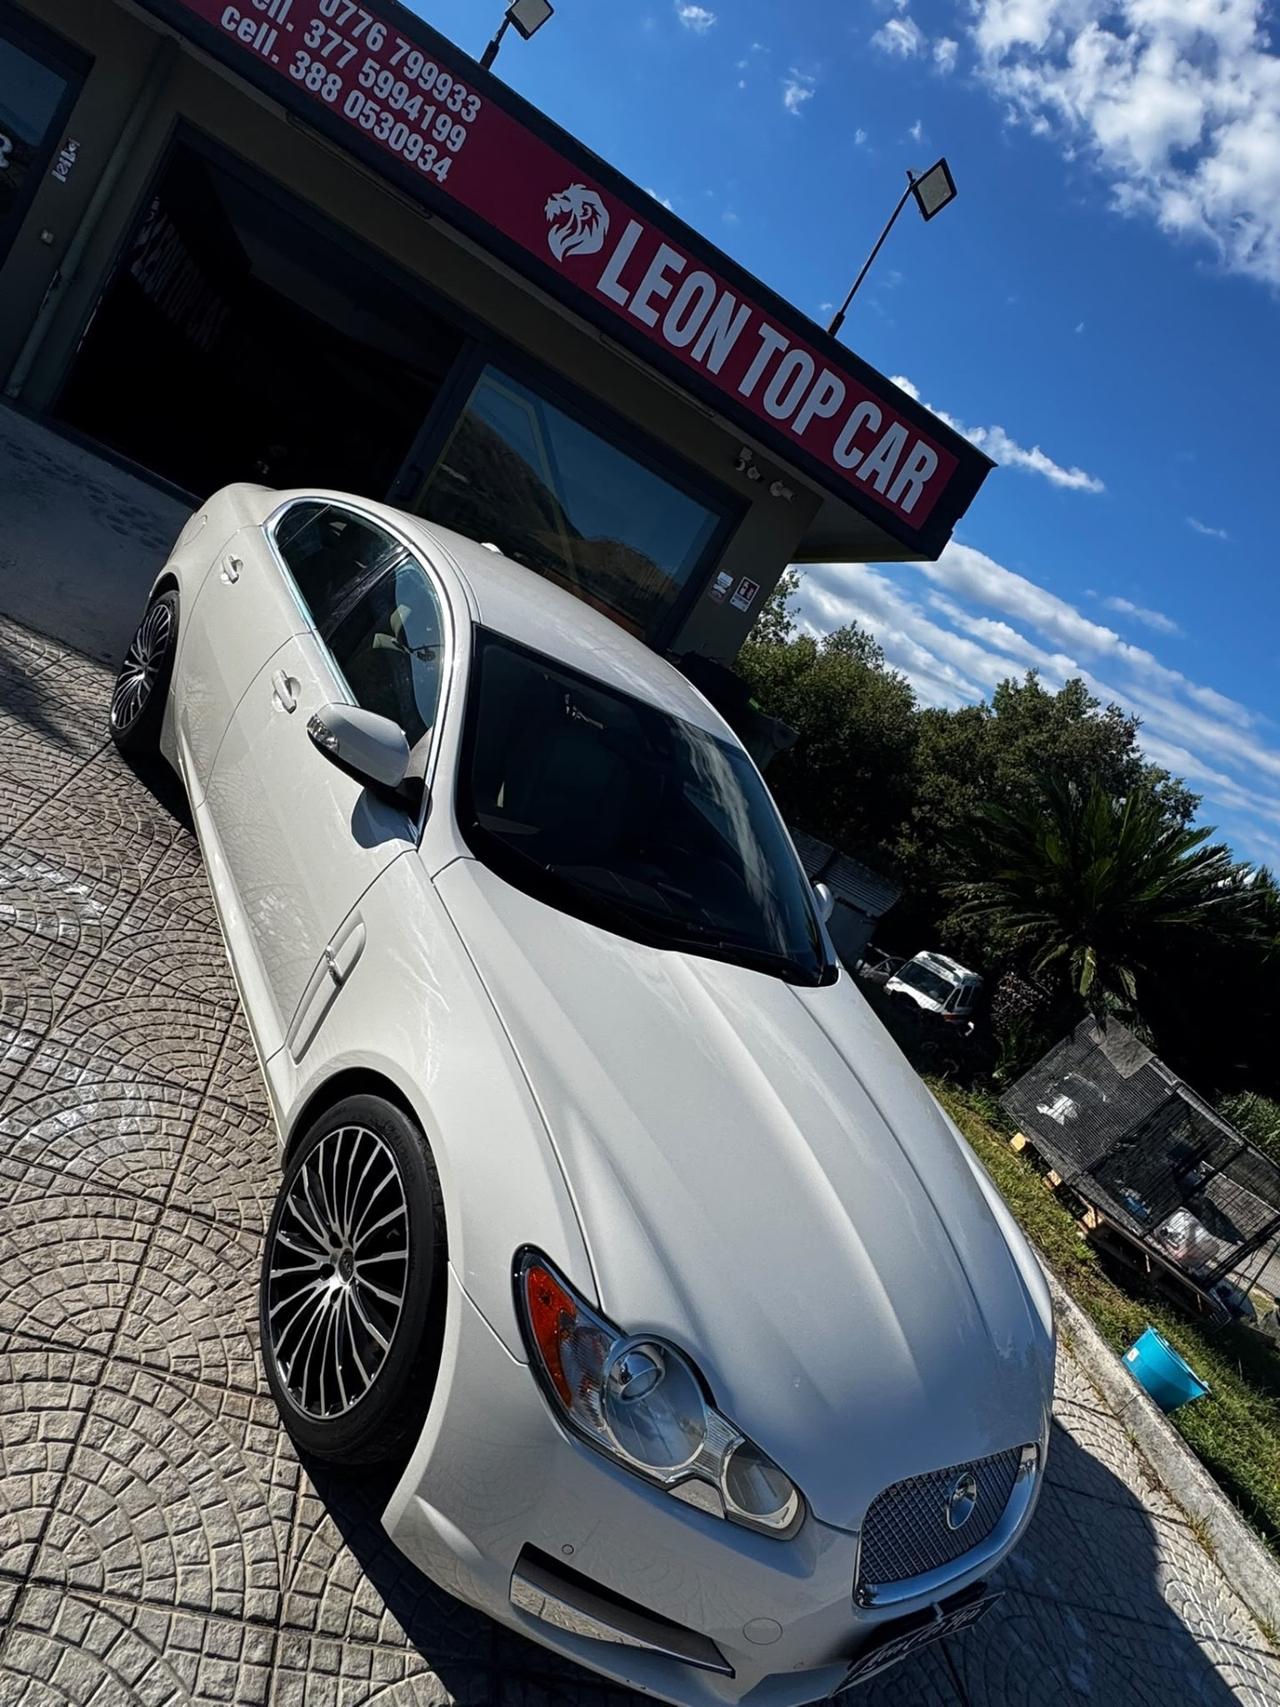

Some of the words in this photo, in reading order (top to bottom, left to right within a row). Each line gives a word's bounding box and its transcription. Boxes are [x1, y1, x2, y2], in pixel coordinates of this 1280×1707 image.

[221, 6, 280, 64] cell.
[289, 50, 343, 103] 388
[343, 89, 453, 183] 0530934
[303, 19, 359, 69] 377
[358, 57, 467, 153] 5994199
[319, 0, 388, 52] 0776
[389, 37, 482, 123] 799933
[596, 219, 753, 375] LEON
[738, 322, 846, 436] TOP
[832, 400, 939, 514] CAR
